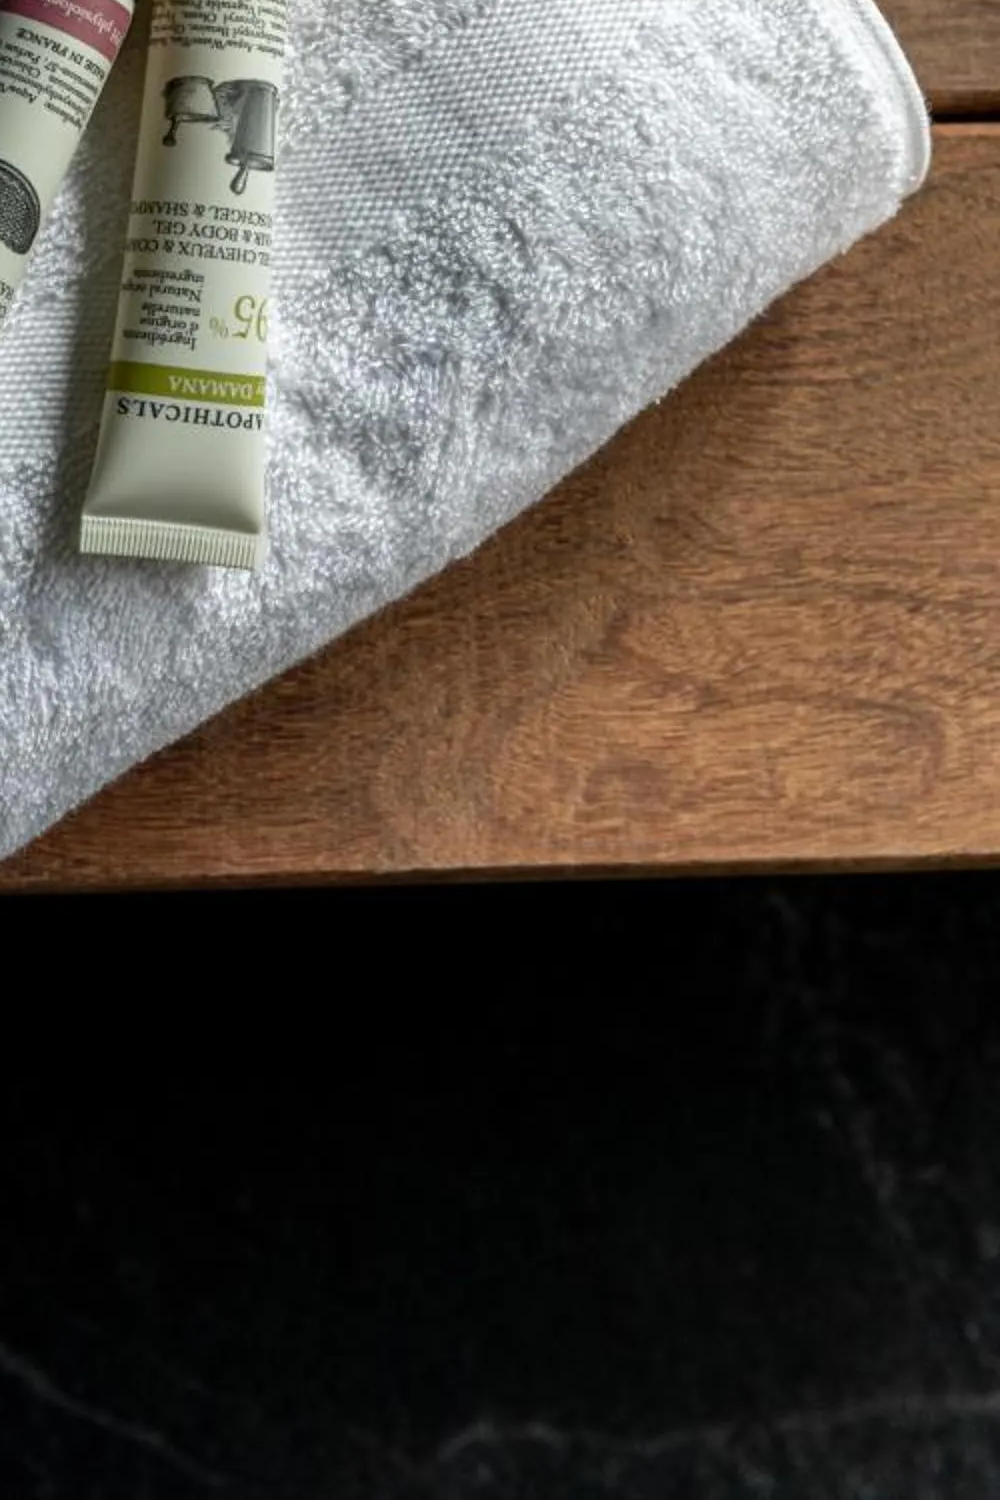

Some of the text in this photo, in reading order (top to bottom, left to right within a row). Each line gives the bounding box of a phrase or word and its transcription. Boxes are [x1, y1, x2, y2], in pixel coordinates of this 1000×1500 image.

[14, 25, 69, 59] FRANCE
[67, 50, 84, 66] IN
[192, 204, 205, 219] &
[151, 219, 186, 235] GEL
[187, 222, 238, 241] BODY
[162, 239, 175, 254] &
[177, 240, 256, 263] CHEVEUX
[168, 375, 255, 400] DAMANA
